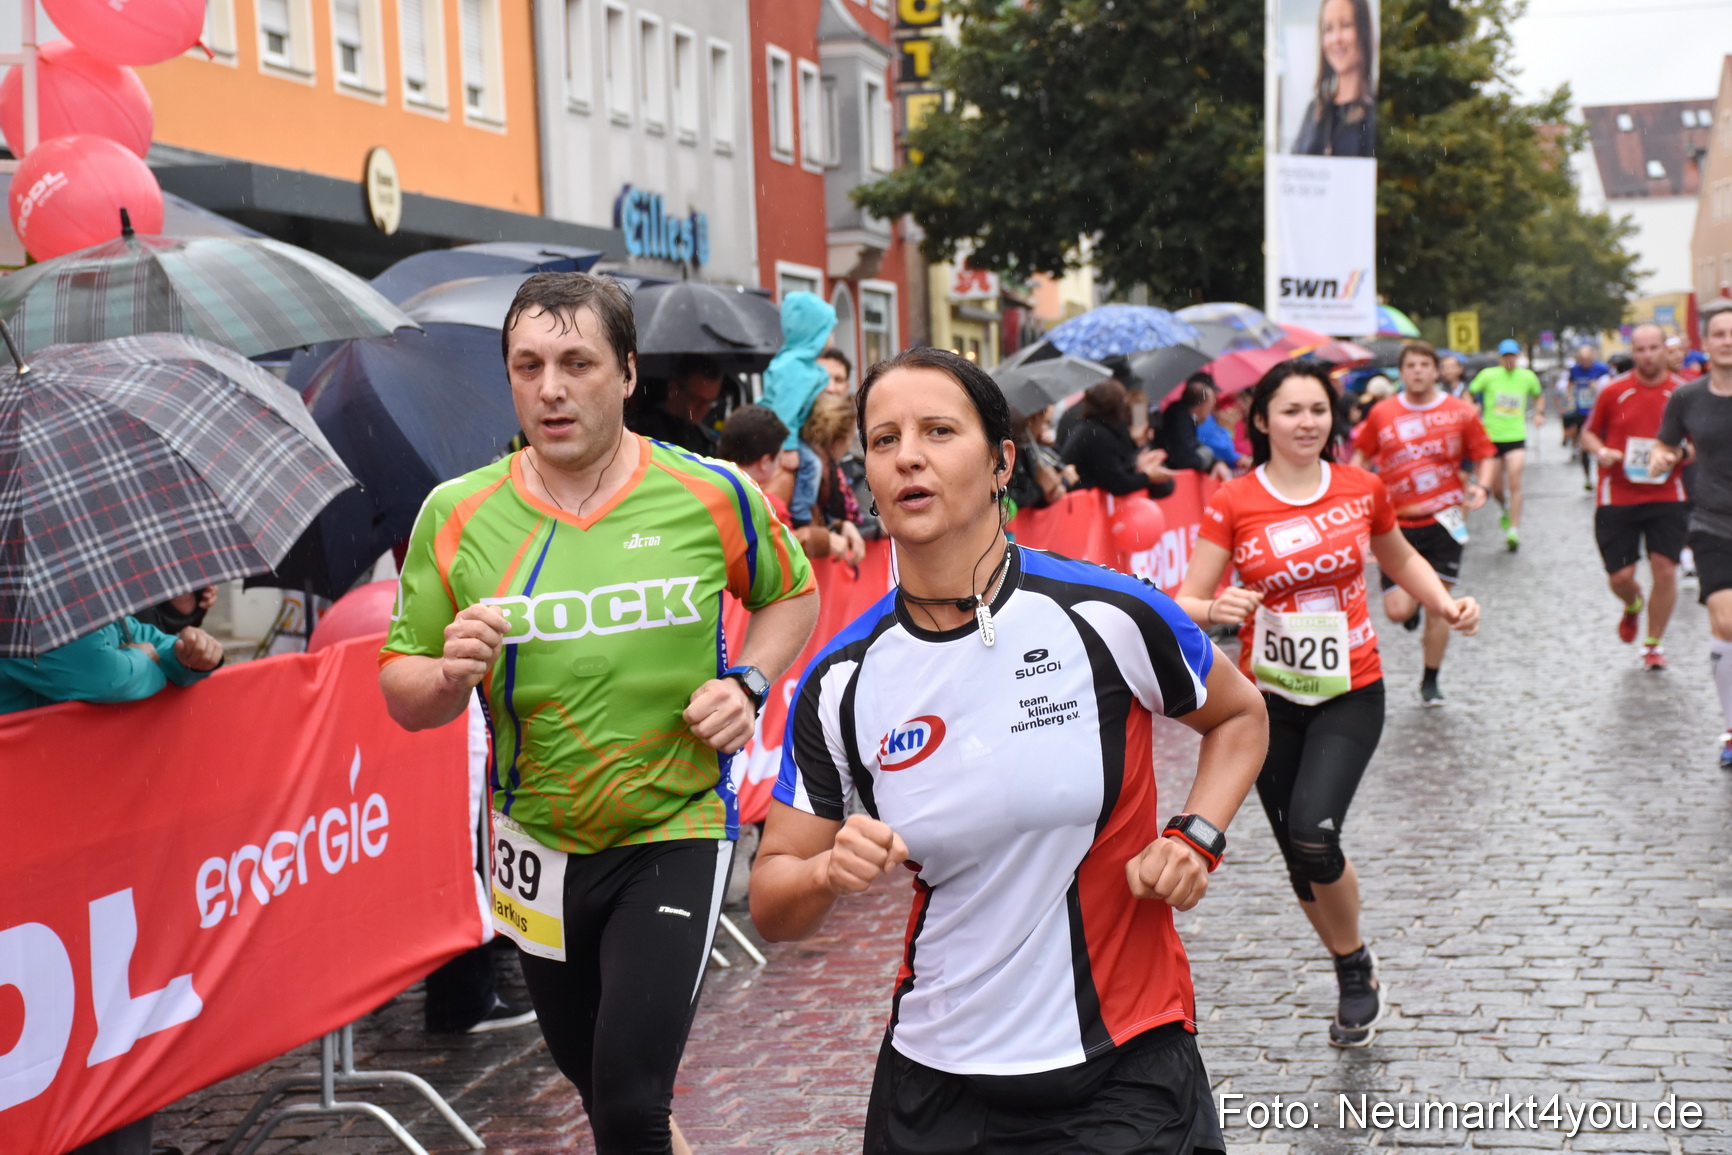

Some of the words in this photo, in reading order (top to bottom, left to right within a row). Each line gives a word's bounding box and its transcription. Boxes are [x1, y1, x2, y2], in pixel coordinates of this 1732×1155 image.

[1279, 278, 1338, 298] swn
[480, 576, 702, 644] BOCK
[1264, 629, 1339, 670] 5026
[1019, 695, 1048, 708] team
[1028, 700, 1078, 718] klinikum
[1011, 714, 1065, 734] nürnberg
[880, 728, 924, 756] tkn
[492, 837, 542, 901] 39
